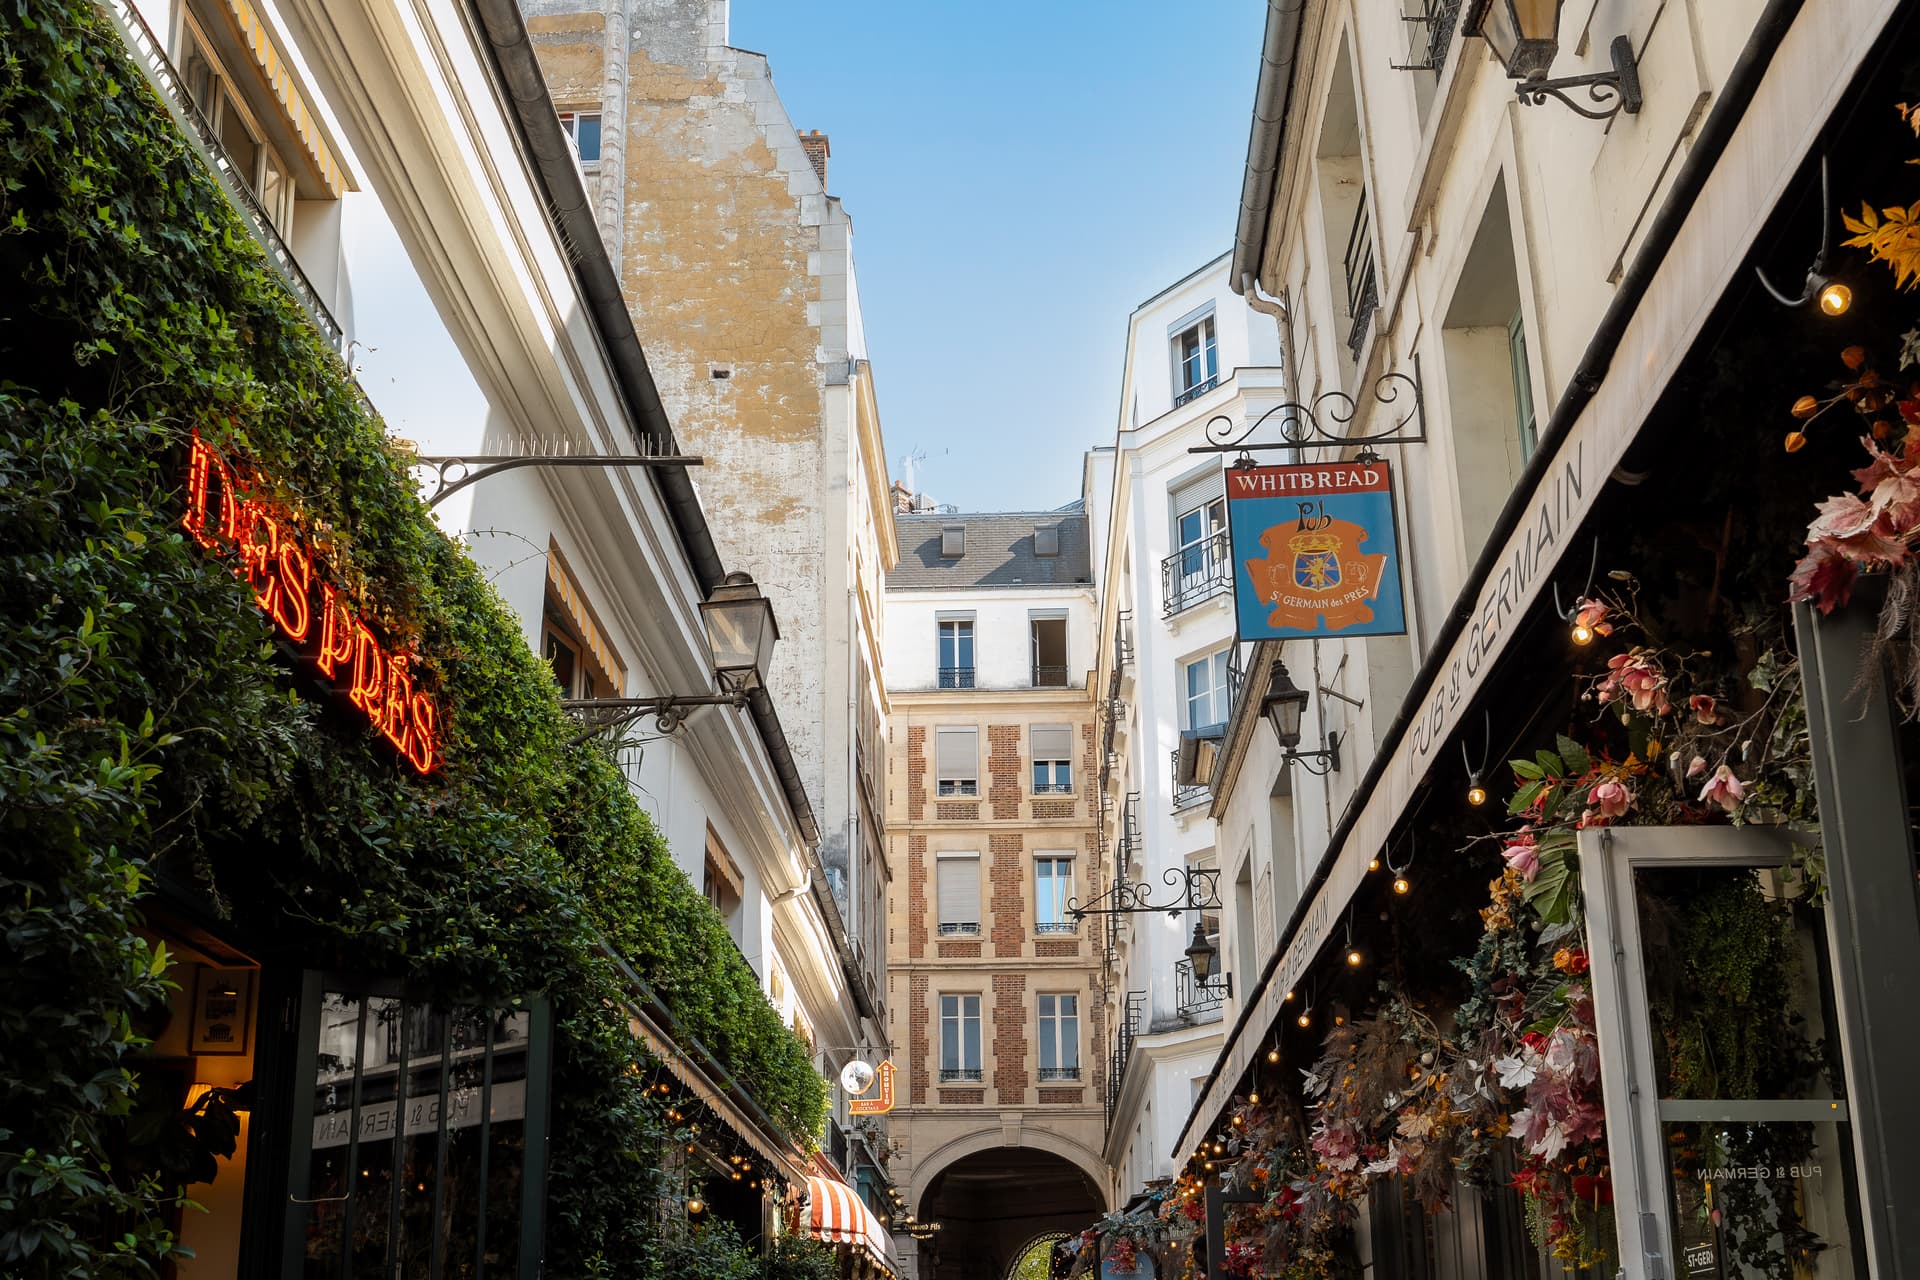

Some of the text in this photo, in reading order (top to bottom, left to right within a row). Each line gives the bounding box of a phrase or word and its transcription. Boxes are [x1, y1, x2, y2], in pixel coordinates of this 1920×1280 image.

[1235, 470, 1380, 491] WHITBREAD
[1296, 499, 1332, 533] Pub
[1283, 595, 1329, 609] GERMAIN
[1330, 599, 1344, 608] des
[1409, 684, 1445, 777] PUB
[1466, 440, 1583, 677] GERMAIN
[1292, 890, 1329, 976] GERMAIN
